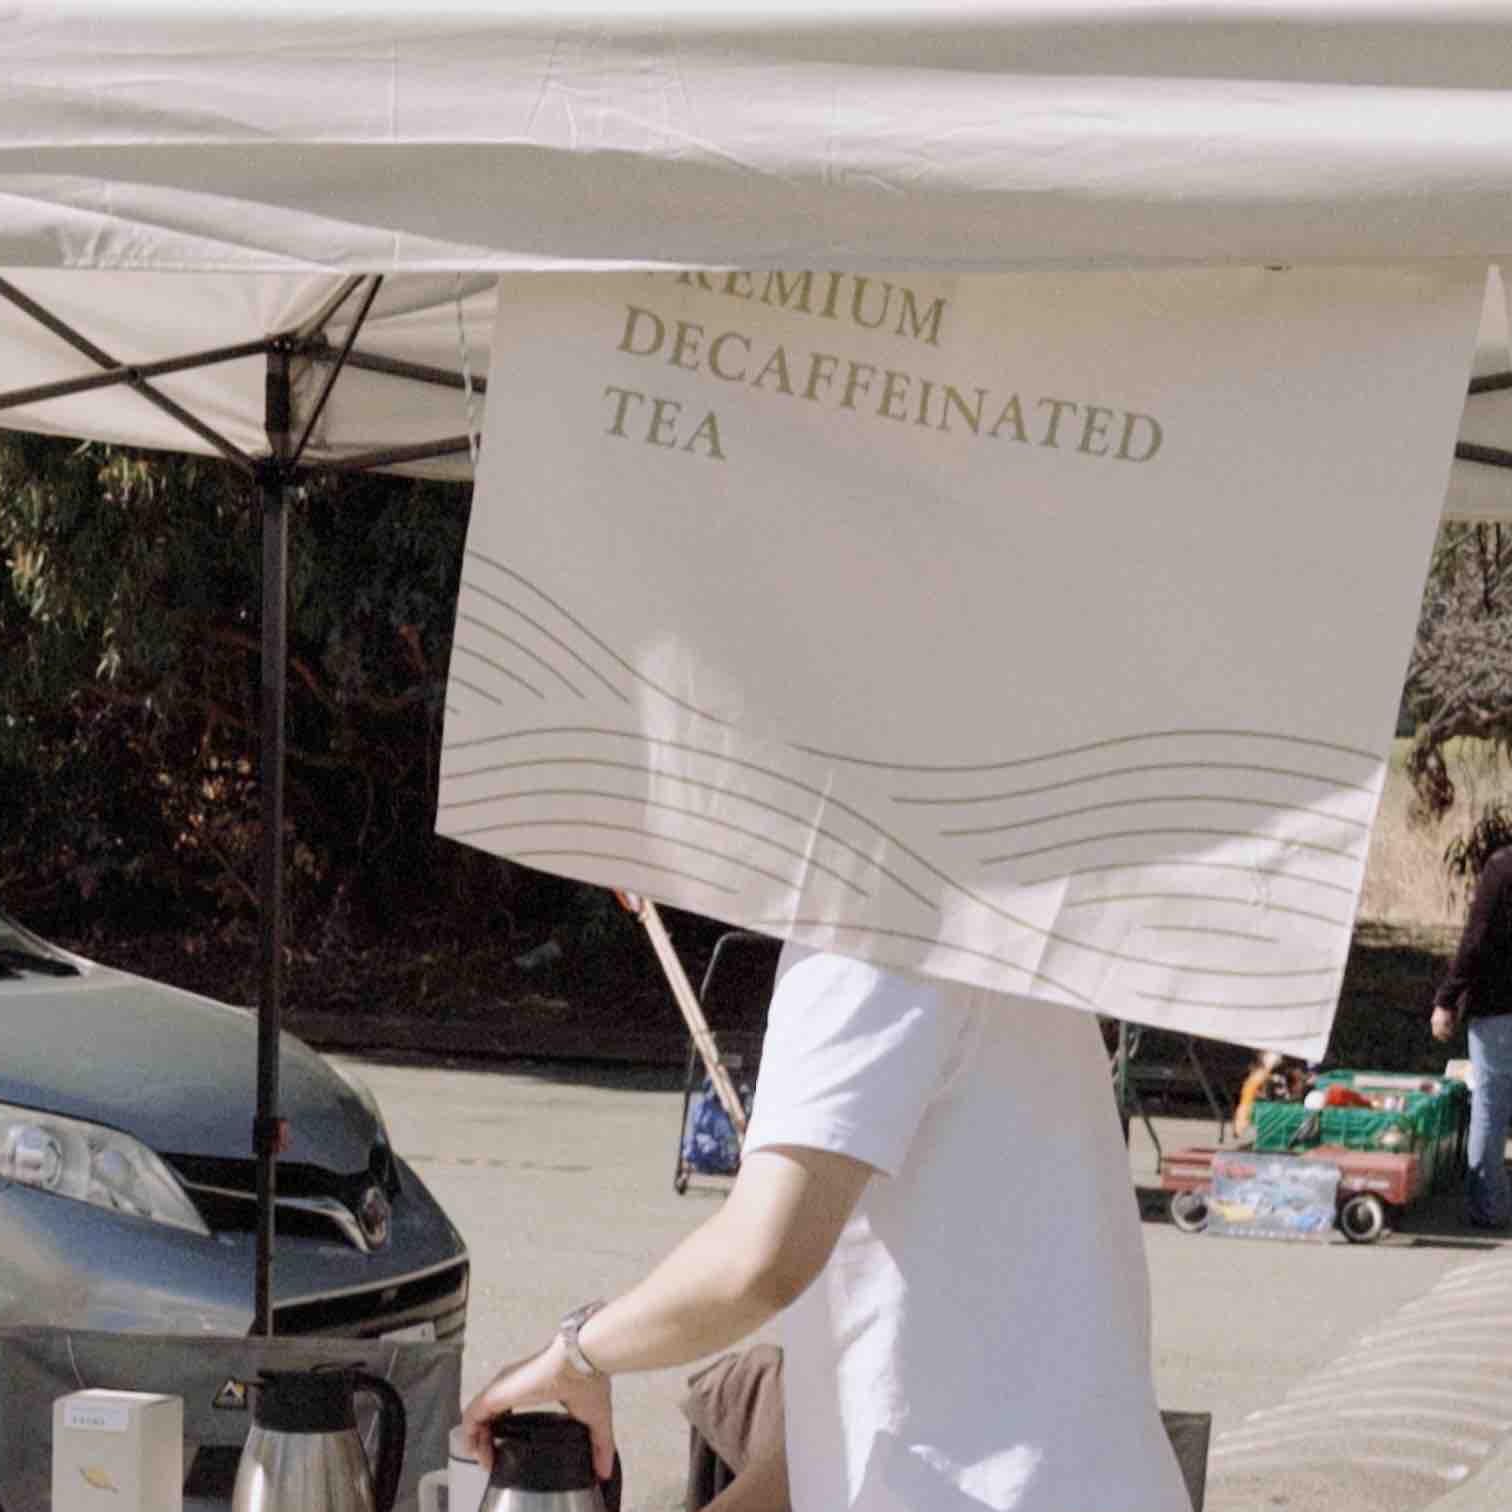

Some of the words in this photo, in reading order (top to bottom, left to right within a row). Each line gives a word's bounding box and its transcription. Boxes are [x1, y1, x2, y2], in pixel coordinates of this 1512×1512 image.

[646, 269, 948, 348] EMIUM
[602, 385, 727, 461] TEA
[616, 303, 1164, 464] DECAFFEINATED
